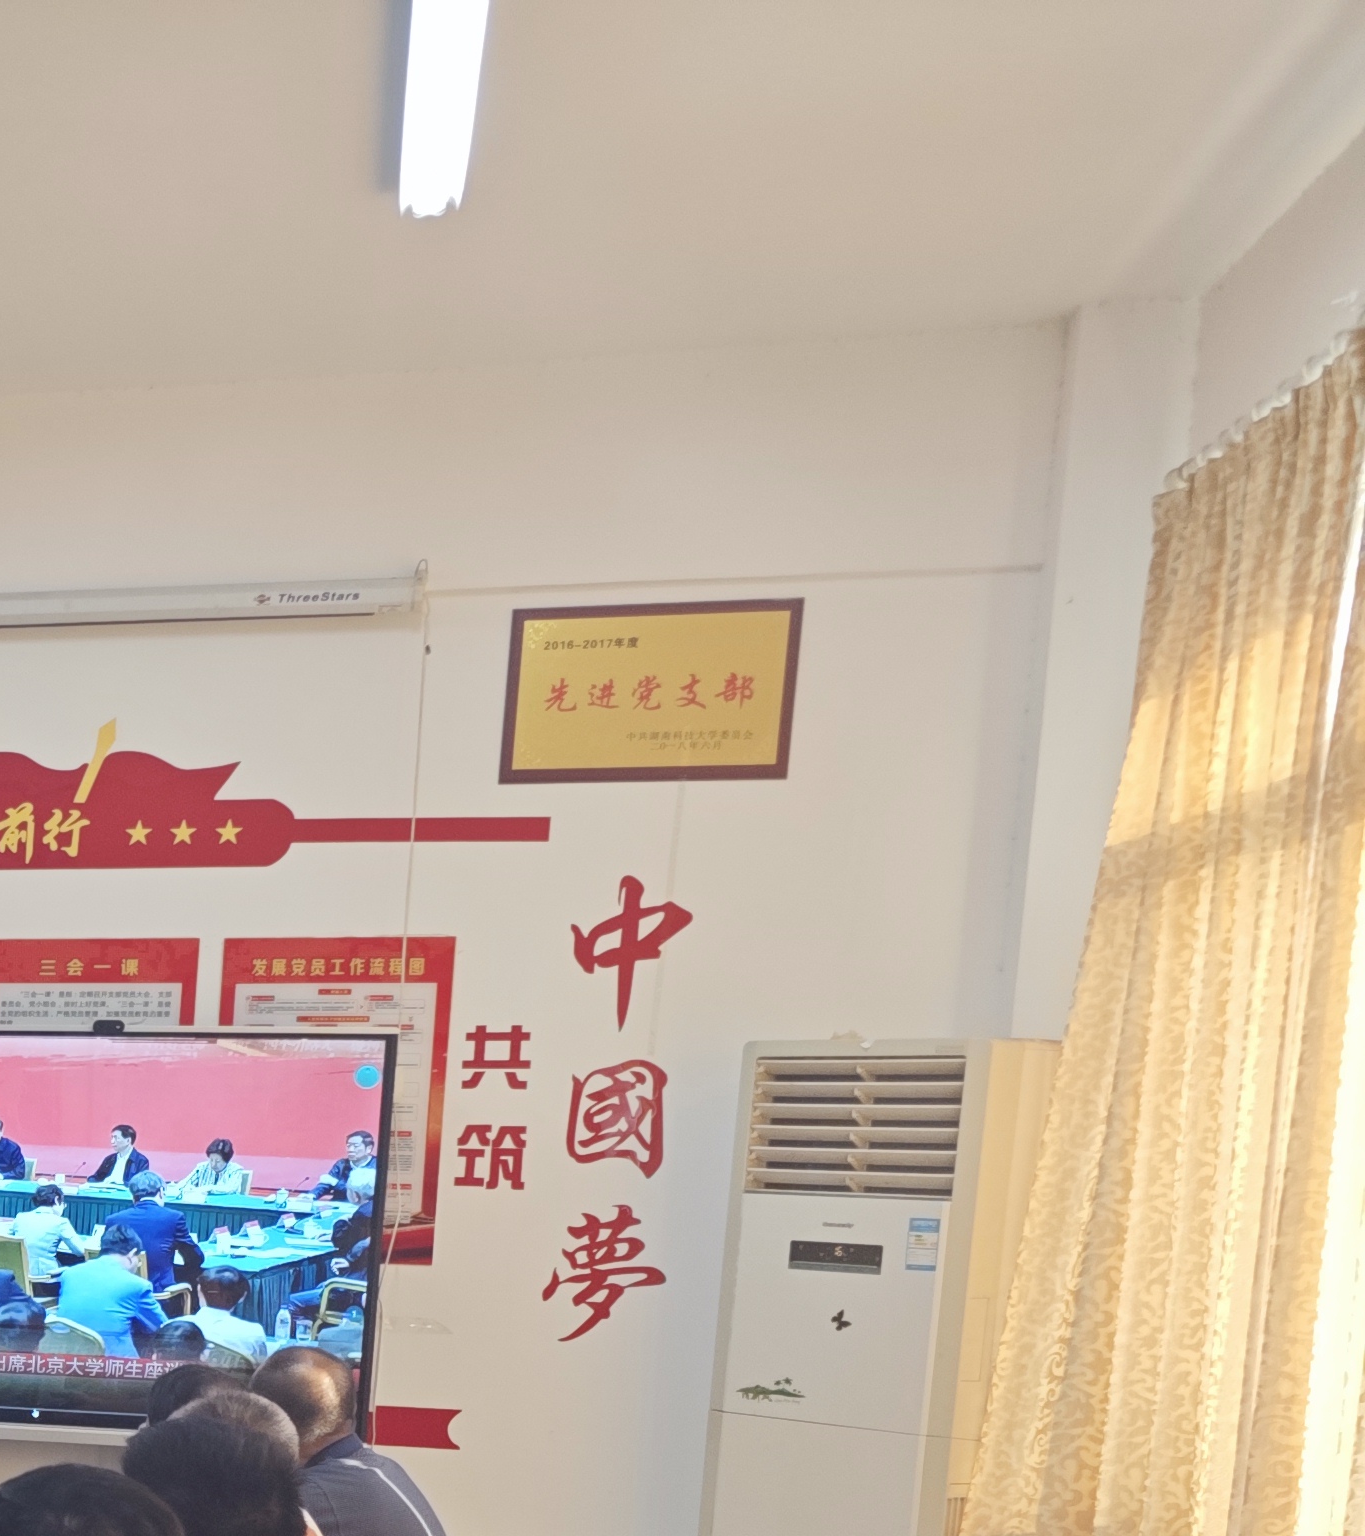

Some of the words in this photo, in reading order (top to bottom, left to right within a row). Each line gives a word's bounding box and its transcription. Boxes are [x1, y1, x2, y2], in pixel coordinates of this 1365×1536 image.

[278, 592, 360, 604] ThreeStars
[544, 672, 755, 713] 先进党支部
[39, 958, 139, 977] 三会一课
[251, 957, 426, 977] 发展党员工作流程图
[454, 1024, 532, 1191] 共筑
